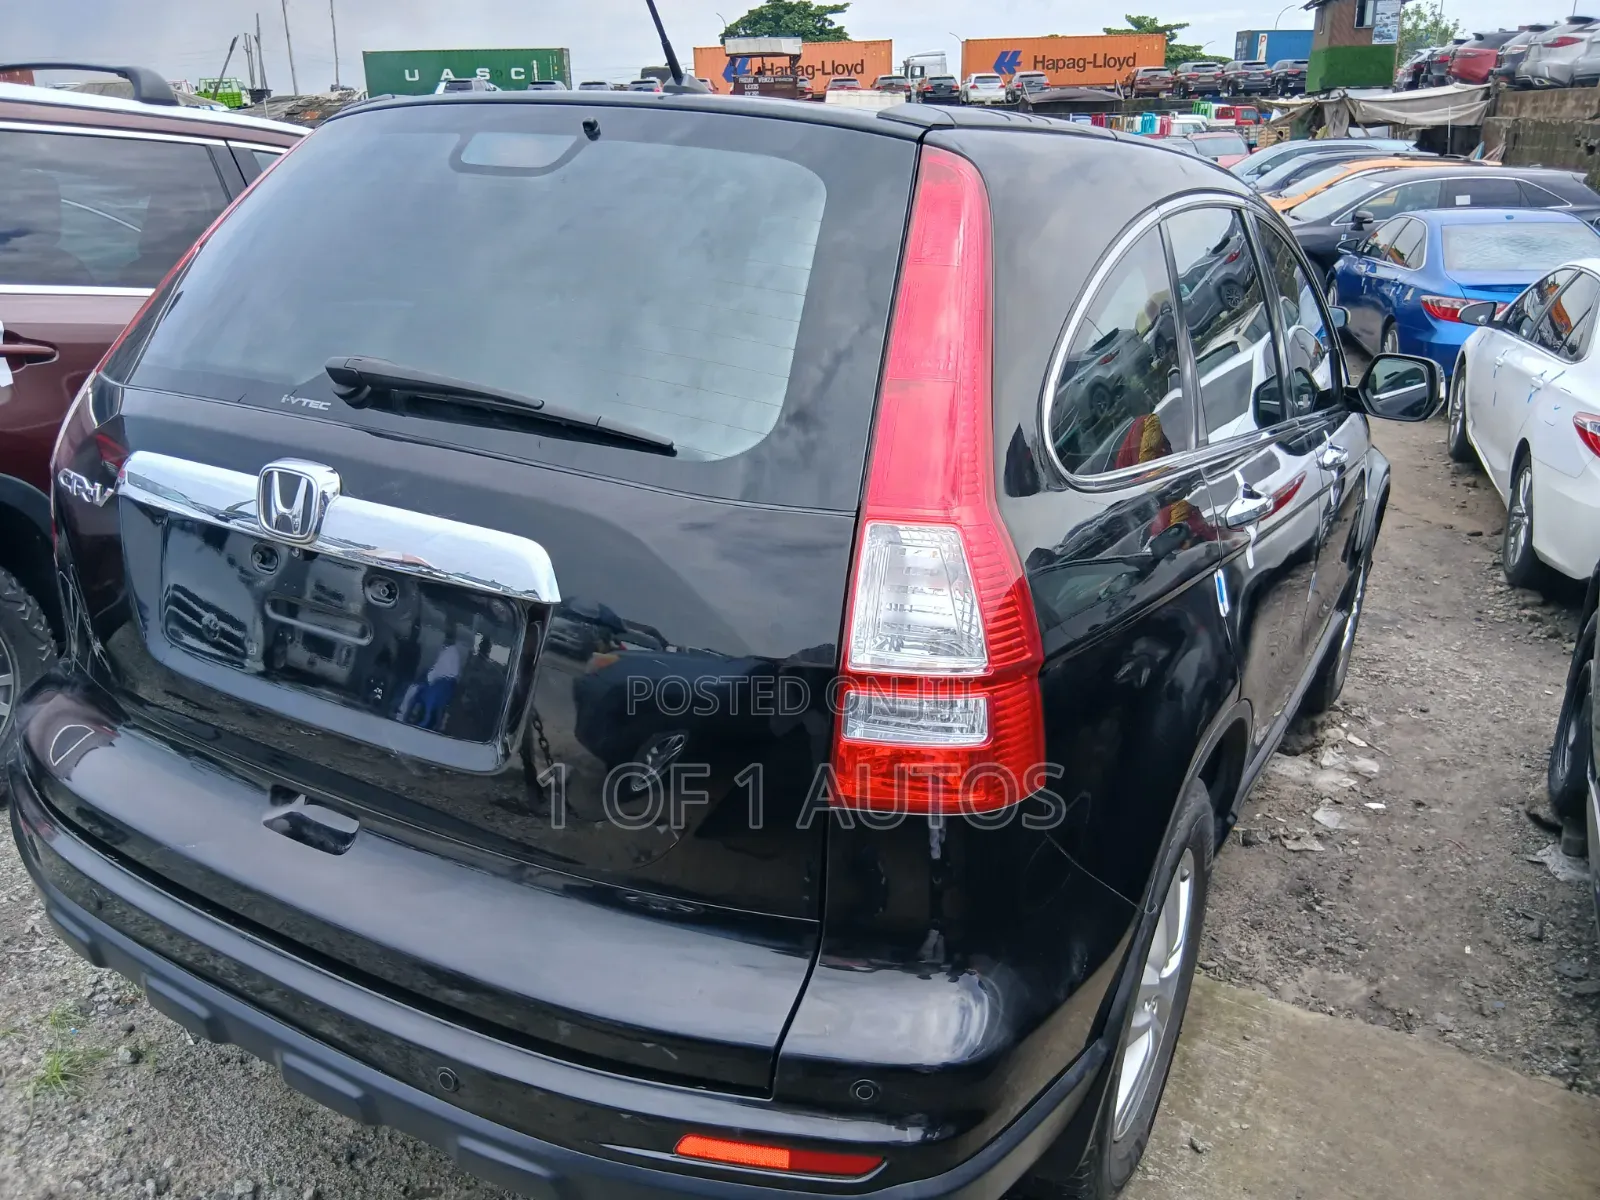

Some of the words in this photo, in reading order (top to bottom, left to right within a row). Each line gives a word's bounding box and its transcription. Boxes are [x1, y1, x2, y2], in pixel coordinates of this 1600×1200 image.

[1033, 52, 1137, 73] Hapag-Lloyd
[281, 394, 332, 411] i-VTEC
[58, 468, 114, 507] CR-V
